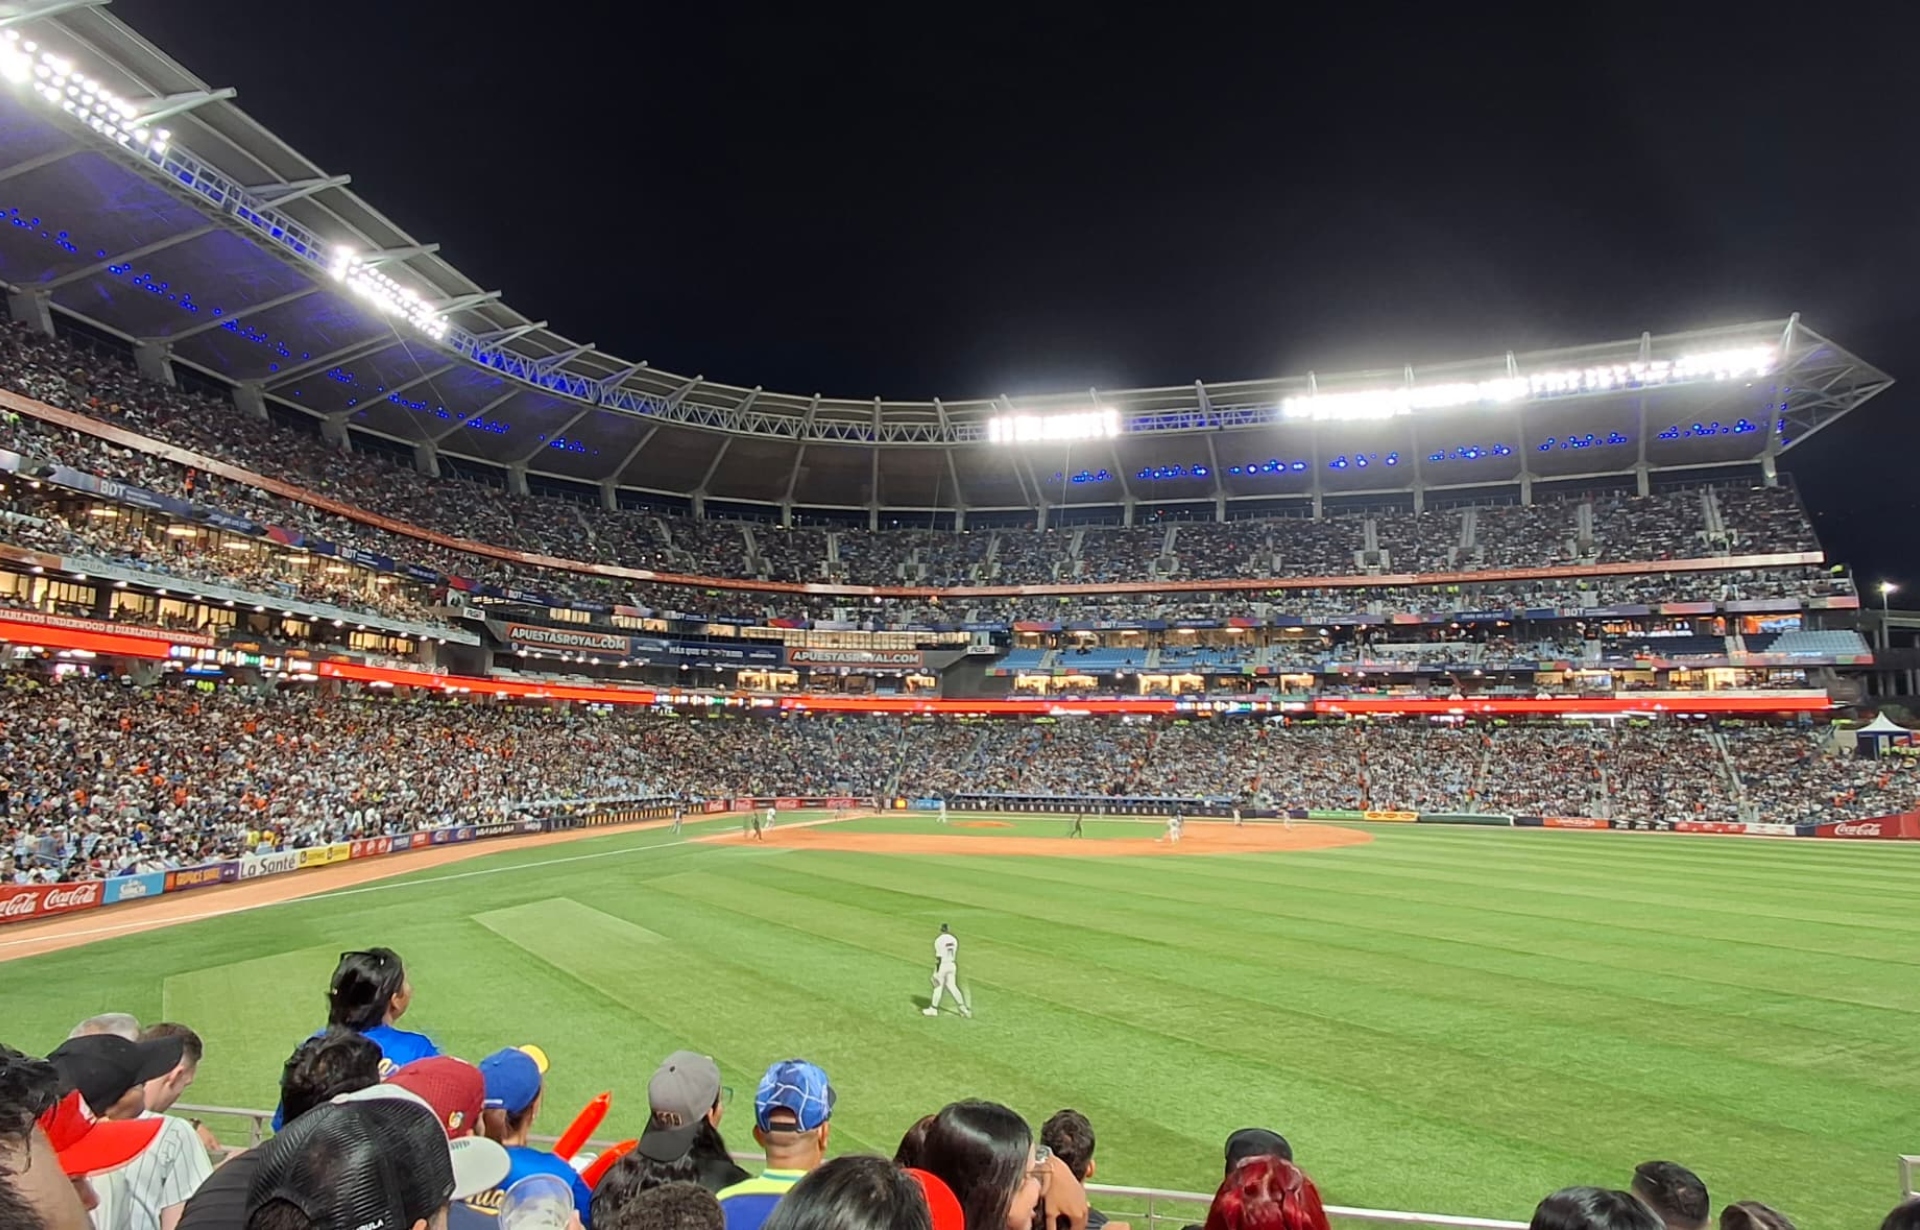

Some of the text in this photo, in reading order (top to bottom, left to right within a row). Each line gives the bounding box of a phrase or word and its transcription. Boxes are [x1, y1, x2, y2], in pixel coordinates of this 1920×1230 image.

[101, 480, 126, 497] BDT
[510, 627, 627, 650] APUESTASROYAL.COM
[792, 651, 920, 664] APUESTASROYAL.COM
[1834, 823, 1882, 836] Coca-Cola
[240, 860, 256, 877] La
[259, 853, 296, 875] Santé
[43, 883, 98, 910] Coca-Cola
